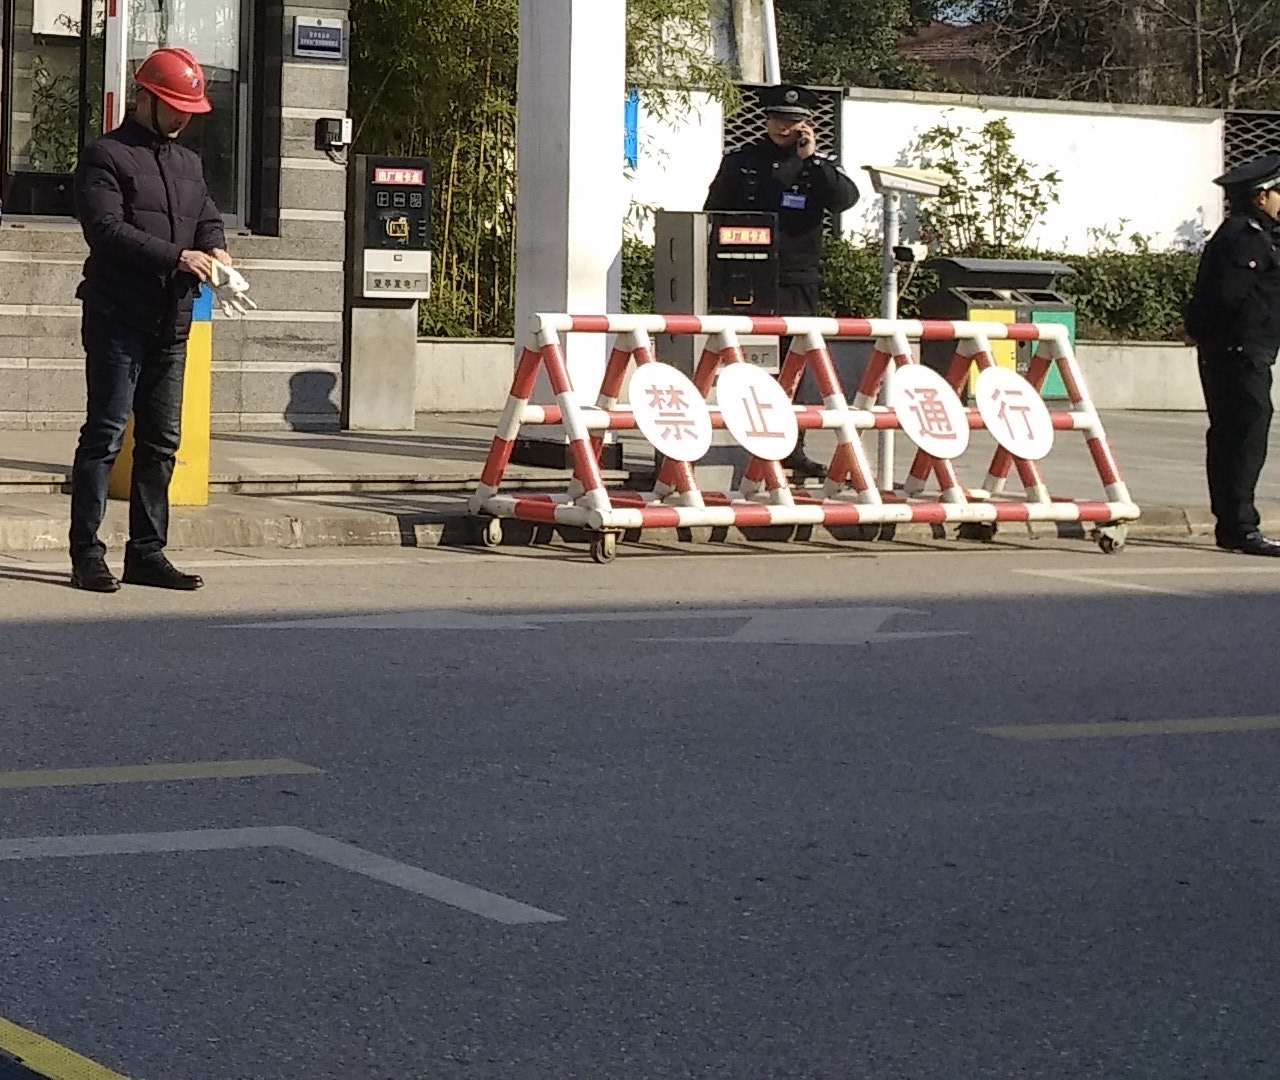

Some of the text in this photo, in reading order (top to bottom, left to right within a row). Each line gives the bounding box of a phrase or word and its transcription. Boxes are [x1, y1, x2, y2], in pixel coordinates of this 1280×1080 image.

[373, 279, 422, 290] 望亭发电厂
[644, 383, 1036, 441] 禁止通行
